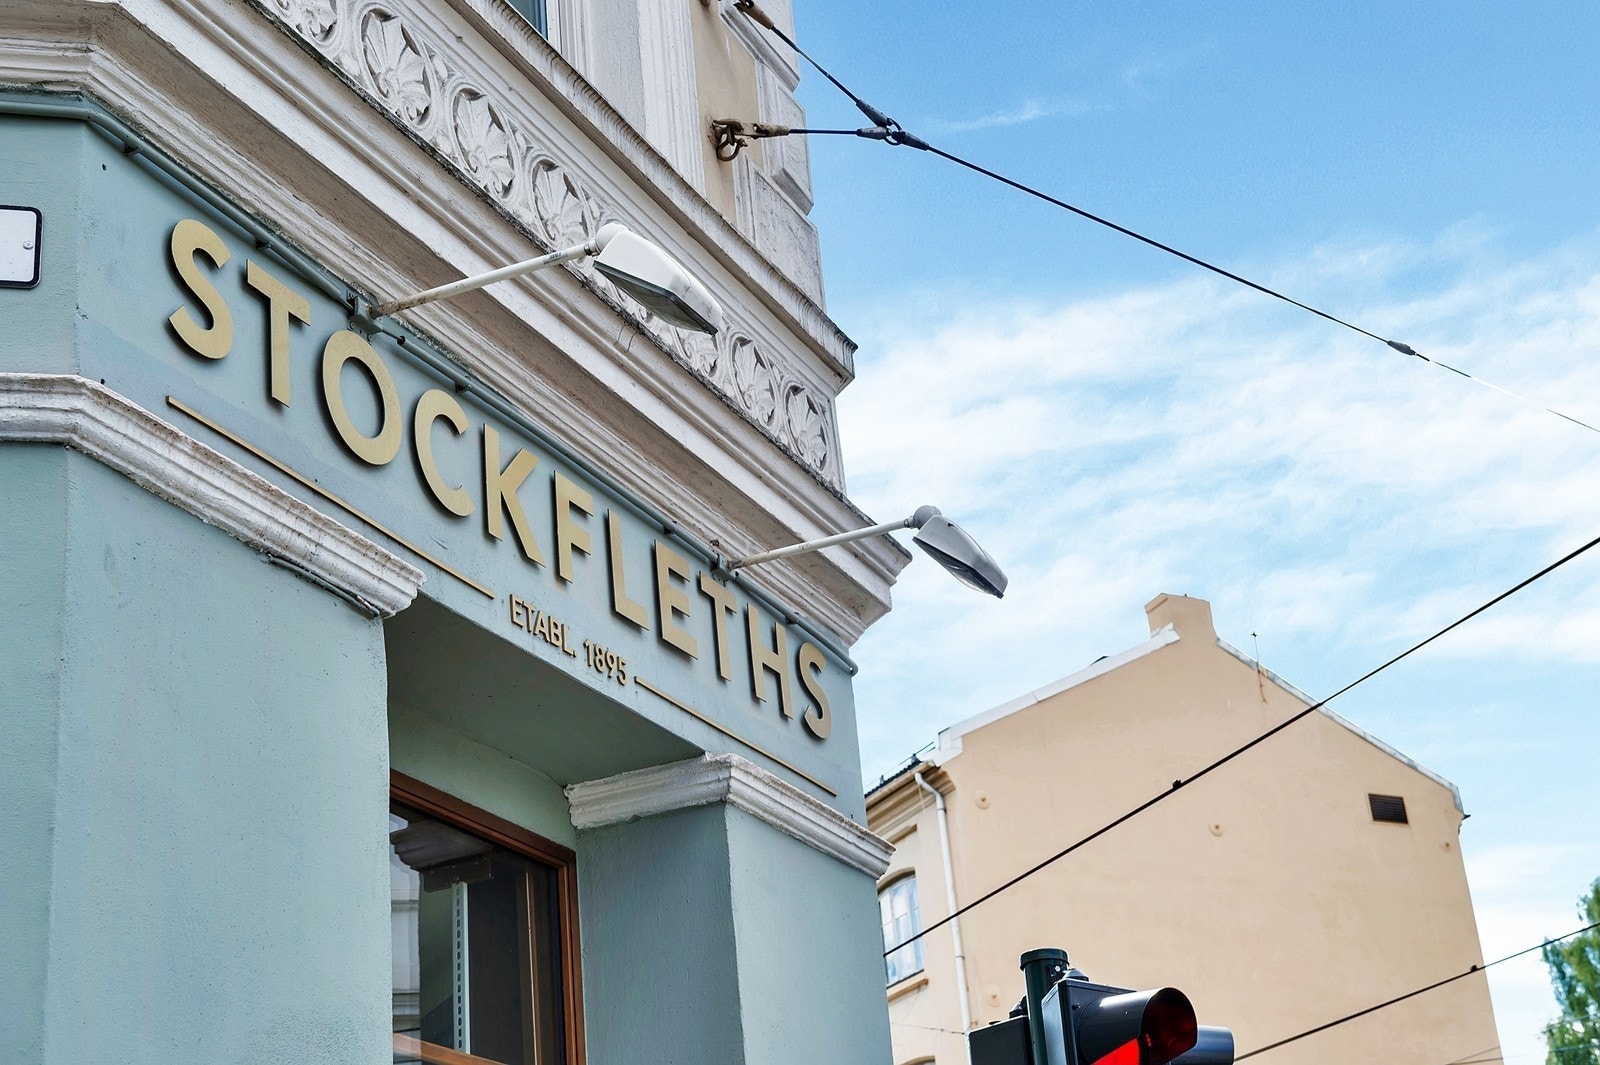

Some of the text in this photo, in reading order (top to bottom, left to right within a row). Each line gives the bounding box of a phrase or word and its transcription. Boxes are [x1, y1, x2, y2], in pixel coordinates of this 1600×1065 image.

[168, 218, 832, 740] STOCKFLETHS
[510, 594, 627, 685] ETABL. 1895
